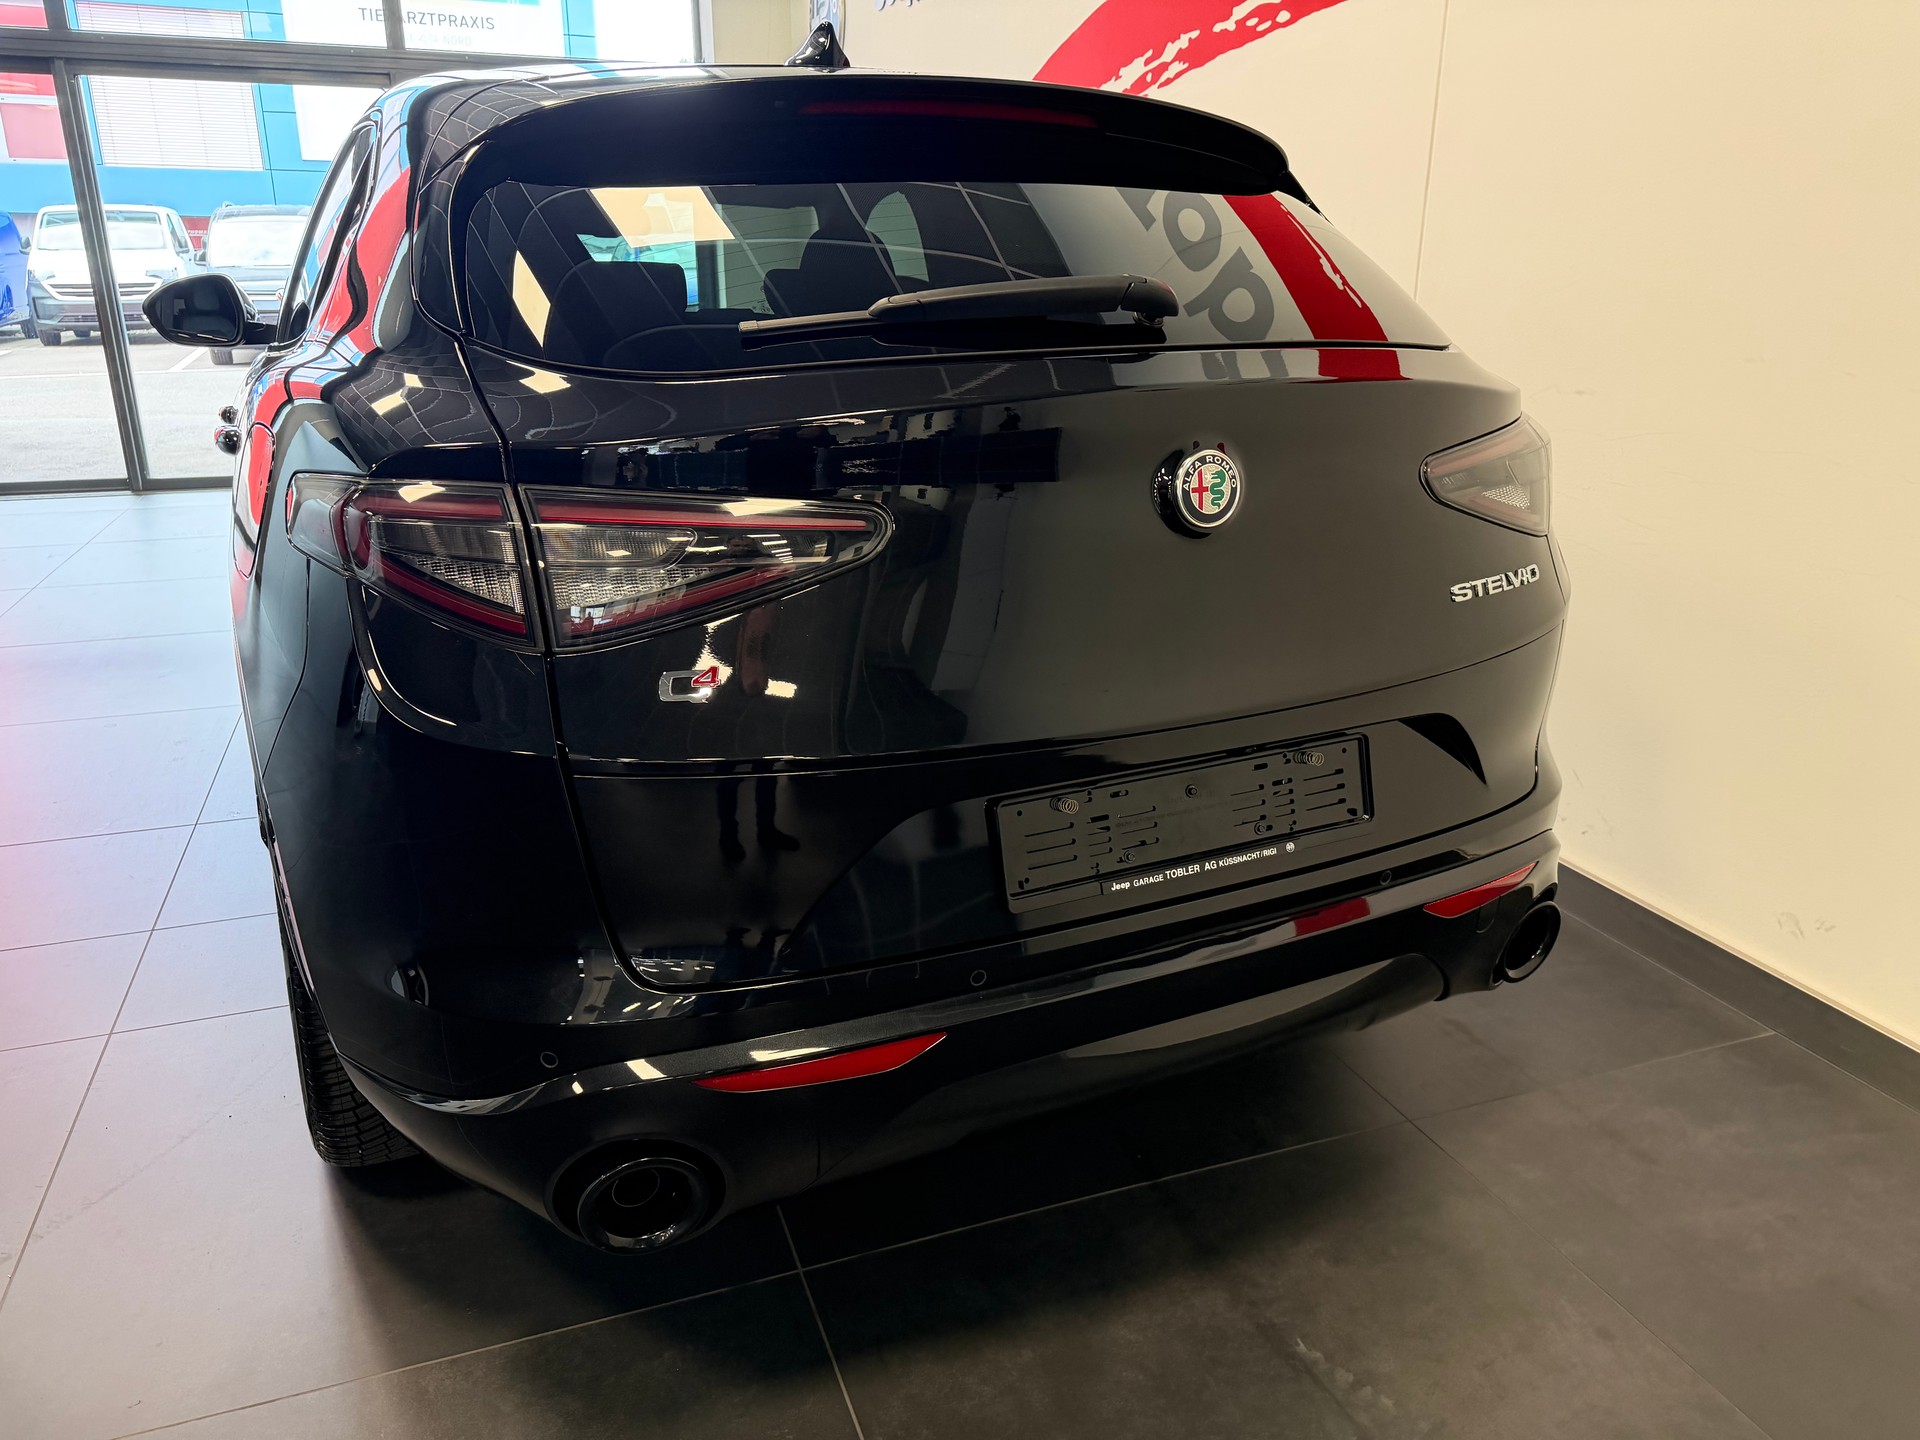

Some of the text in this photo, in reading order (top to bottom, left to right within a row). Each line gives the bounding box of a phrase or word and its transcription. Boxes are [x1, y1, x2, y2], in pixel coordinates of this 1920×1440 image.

[358, 7, 496, 30] TIERZTPRAXIS
[1183, 455, 1237, 491] ALFA ROMEO
[1450, 563, 1540, 602] STELVIO
[1111, 881, 1131, 892] Jeep
[1133, 874, 1164, 887] GARAGE
[1165, 864, 1200, 880] TOBLER
[1204, 860, 1217, 871] AG
